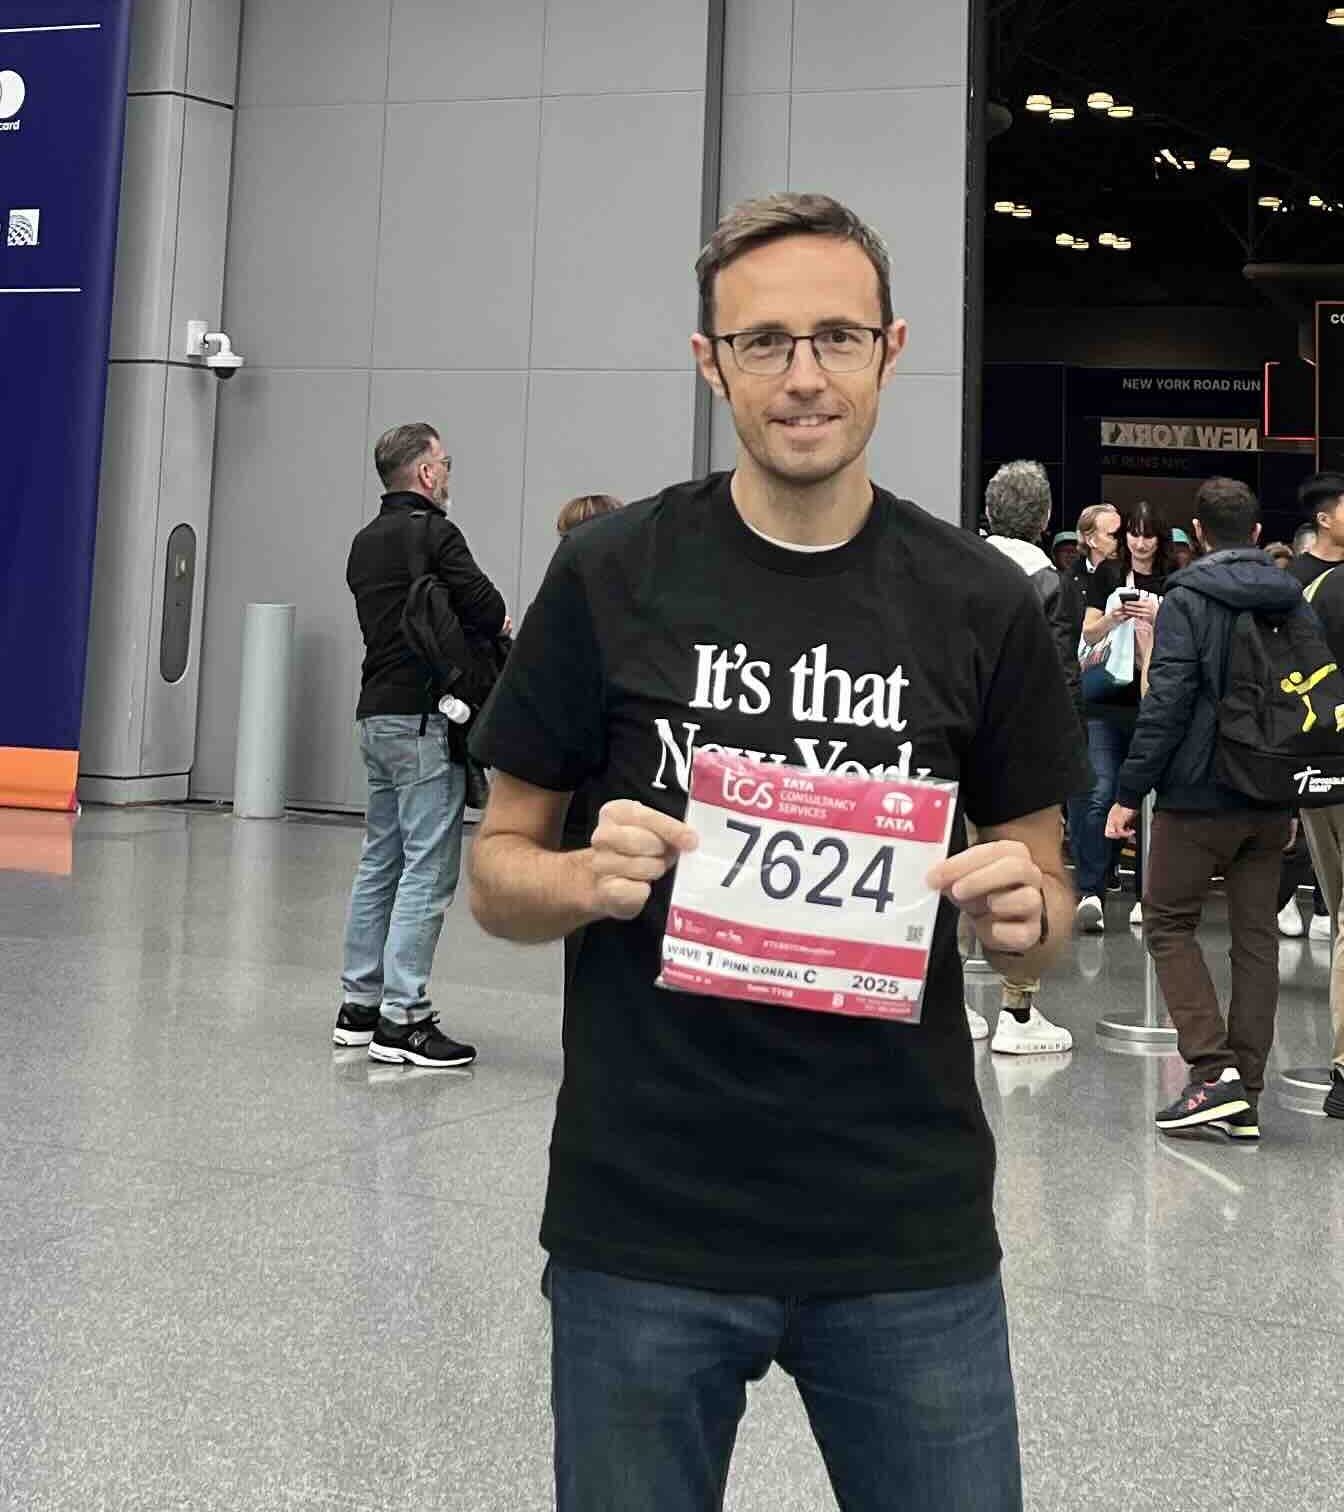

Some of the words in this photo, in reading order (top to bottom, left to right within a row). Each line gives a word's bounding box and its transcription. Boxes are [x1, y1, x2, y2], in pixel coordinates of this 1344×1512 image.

[1122, 377, 1152, 390] NEW
[1156, 378, 1190, 391] YORK
[1194, 379, 1230, 391] ROAD
[689, 643, 771, 715] It's
[790, 643, 910, 733] that
[721, 766, 774, 809] tcs
[783, 777, 815, 793] TATA
[777, 802, 828, 819] SERVICES
[779, 788, 857, 812] CONSULTANCY
[874, 815, 915, 832] TATA
[719, 819, 897, 914] 7624
[667, 941, 702, 961] WAVE
[721, 958, 750, 974] PINK
[803, 968, 817, 984] C
[851, 974, 900, 995] 2025
